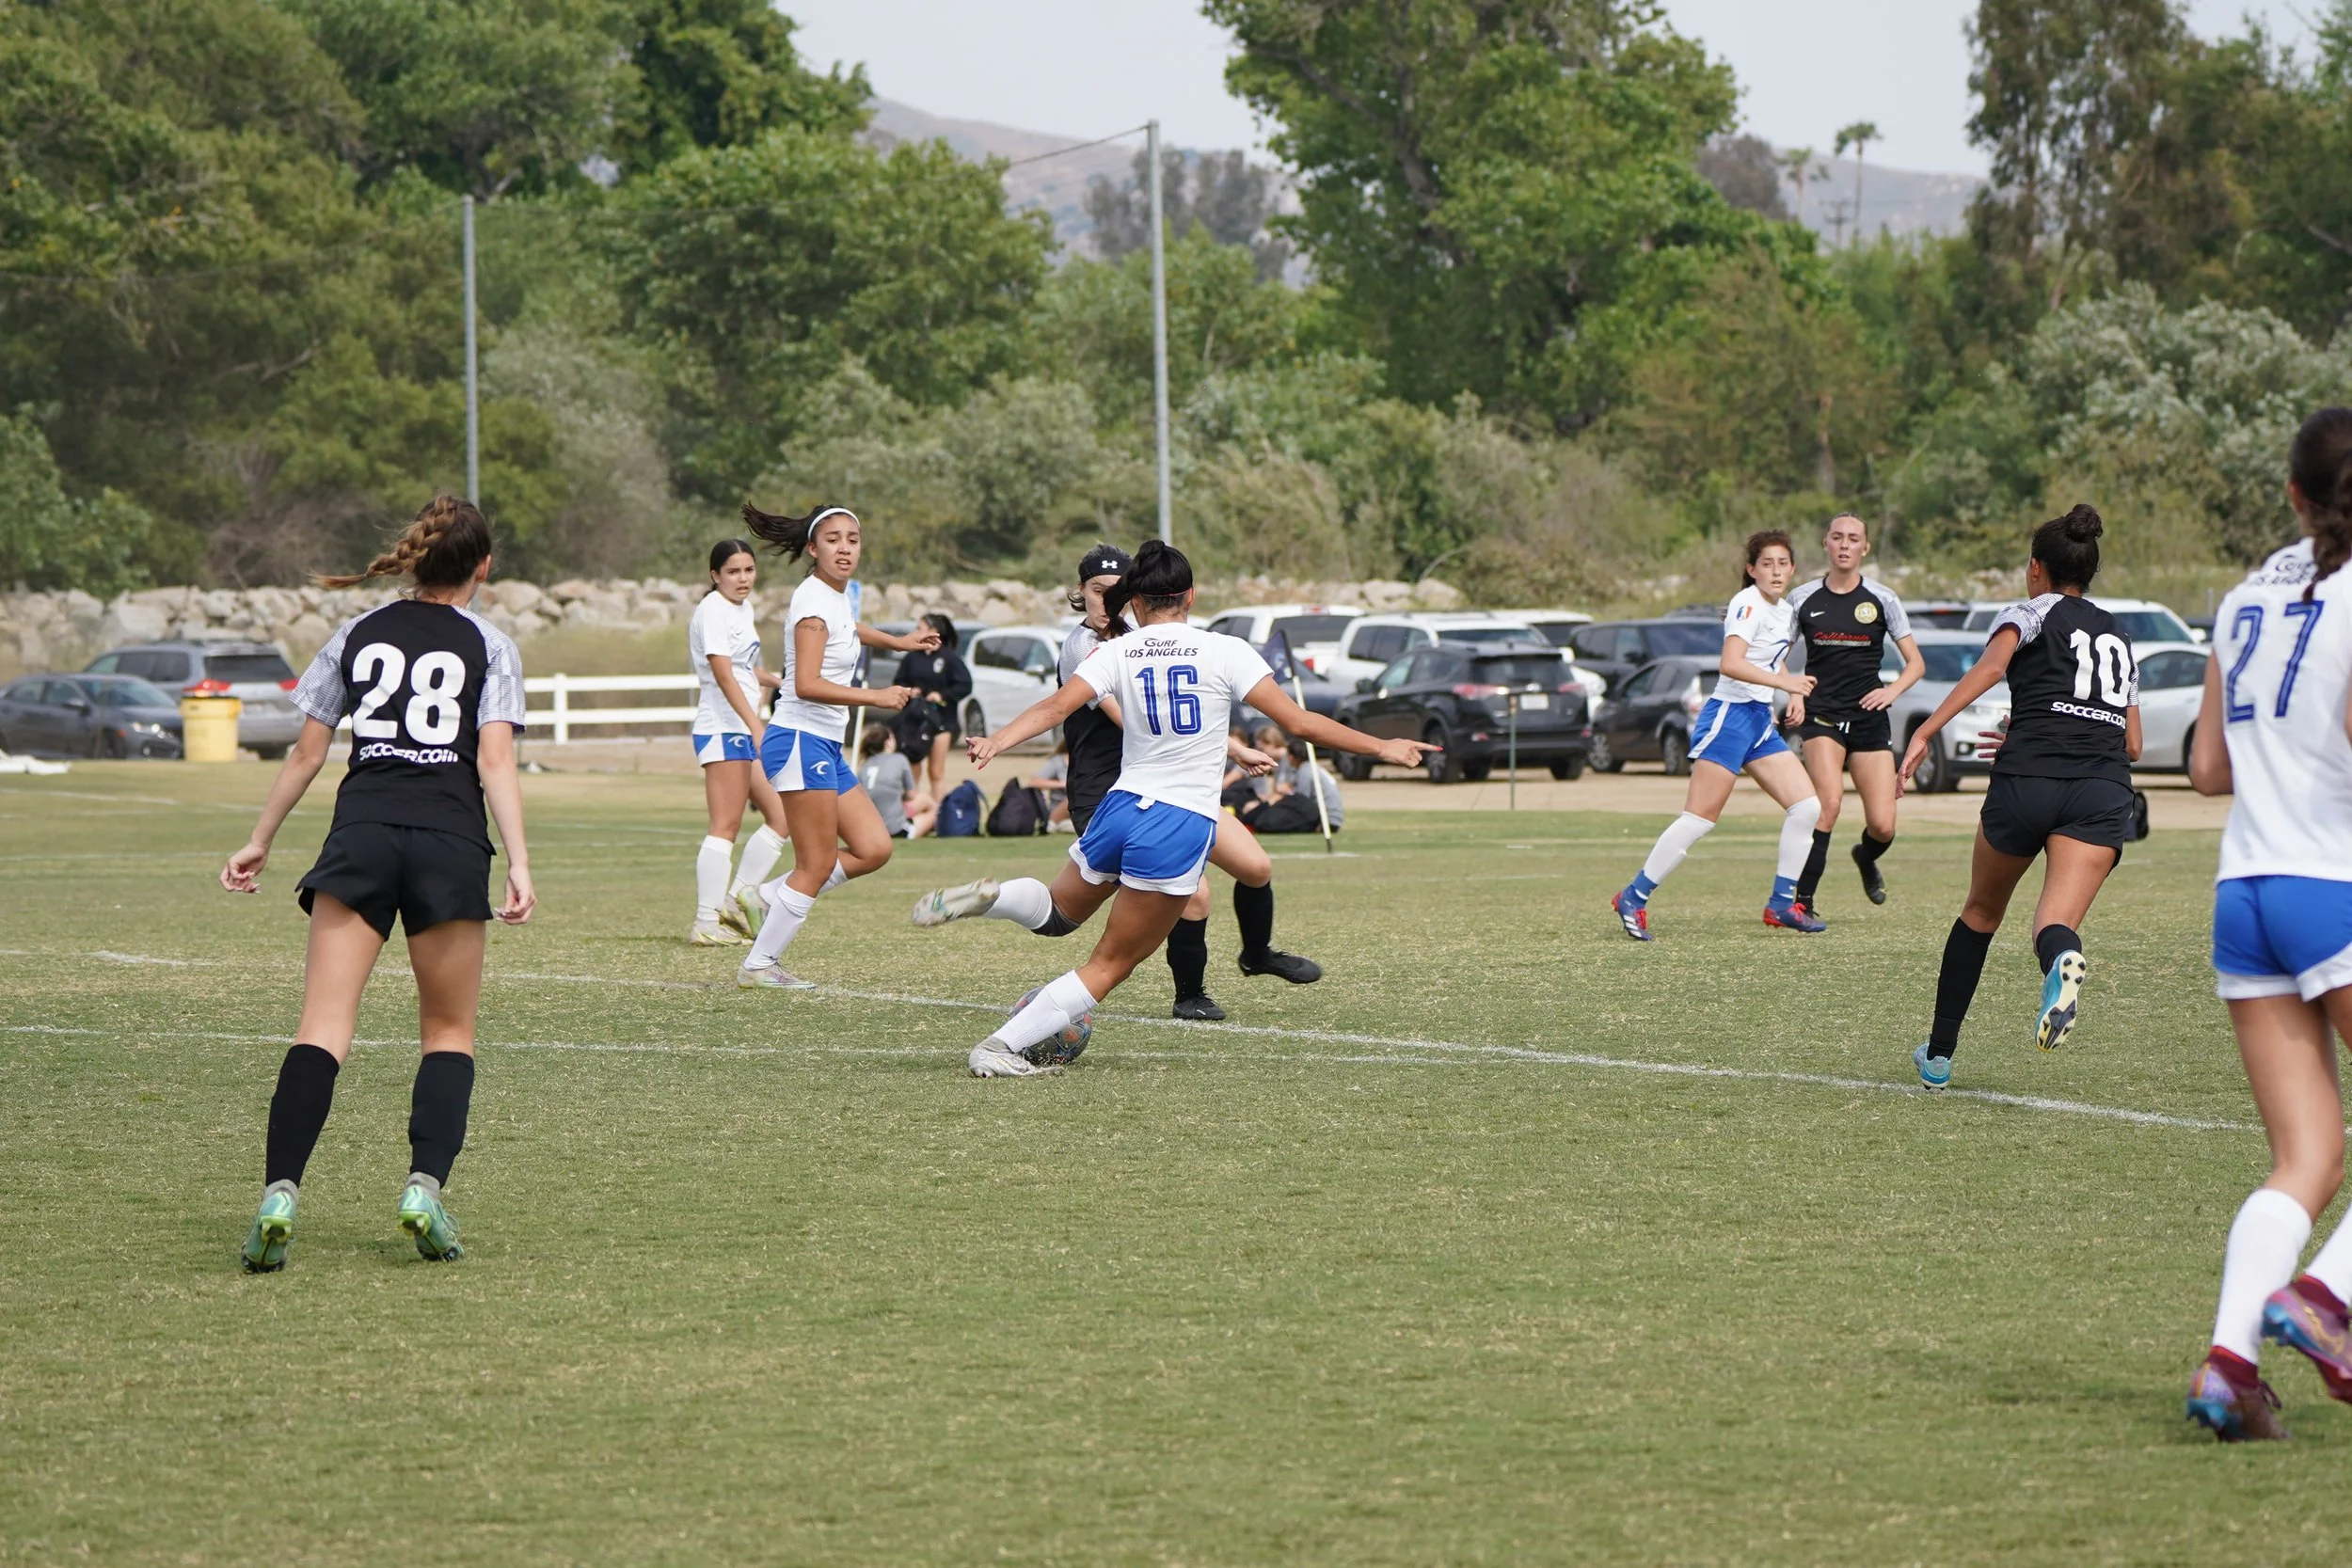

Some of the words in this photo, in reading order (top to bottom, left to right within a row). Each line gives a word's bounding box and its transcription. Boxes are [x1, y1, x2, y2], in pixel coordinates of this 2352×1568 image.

[1125, 649, 1144, 657] LOS
[1146, 648, 1199, 657] ANGELES
[2070, 628, 2131, 707] 10
[2227, 600, 2325, 722] 27
[352, 642, 466, 745] 28
[1135, 664, 1202, 736] 16
